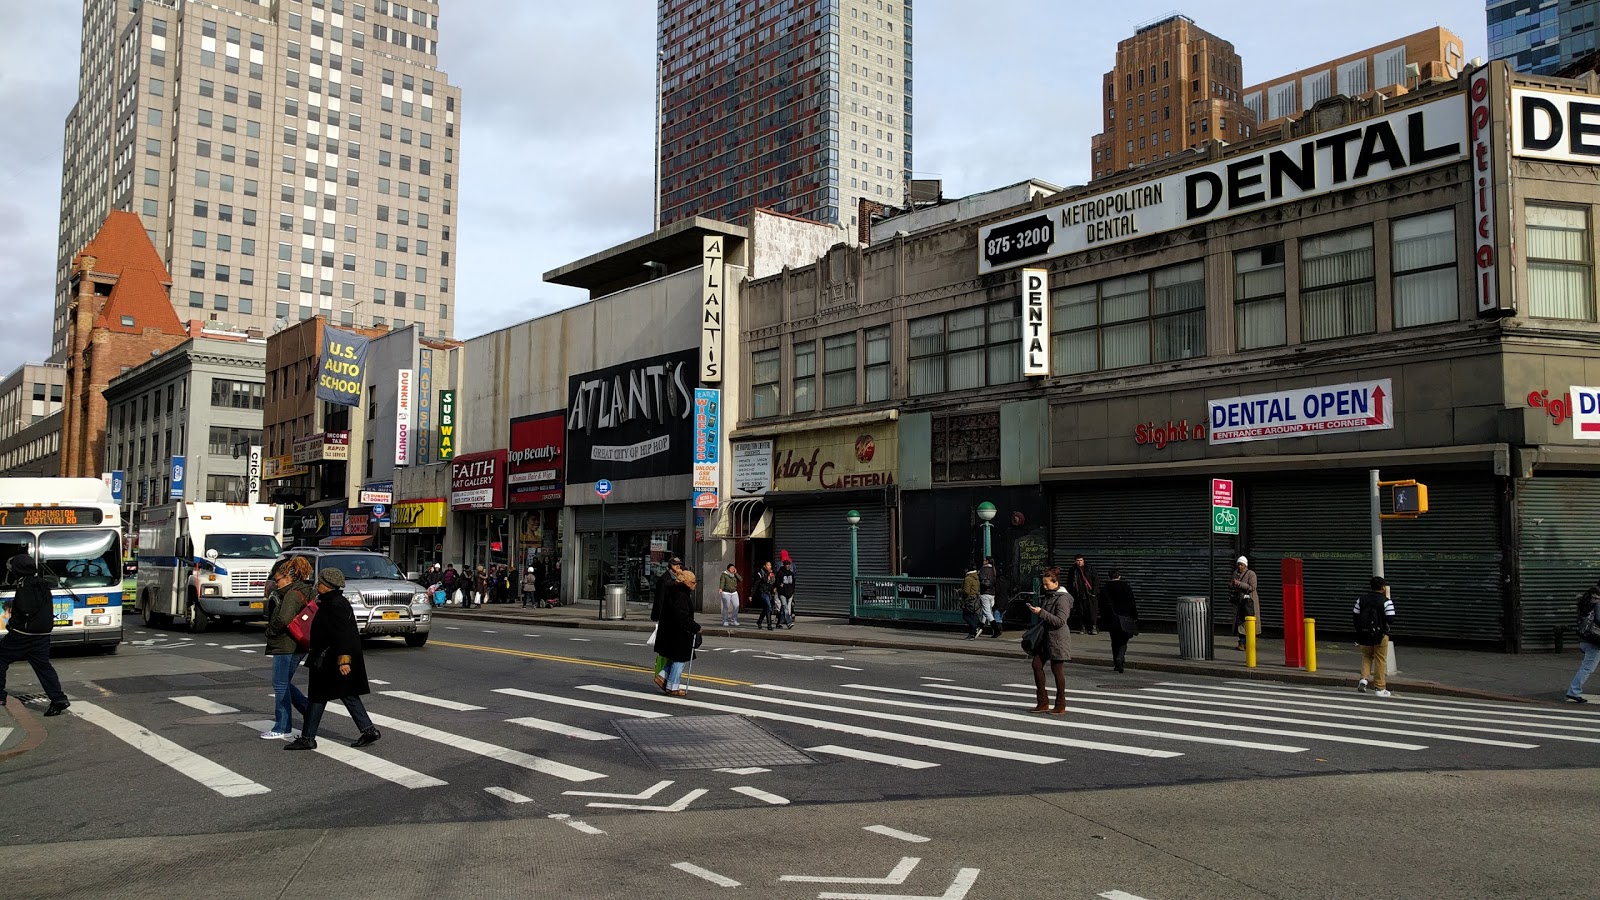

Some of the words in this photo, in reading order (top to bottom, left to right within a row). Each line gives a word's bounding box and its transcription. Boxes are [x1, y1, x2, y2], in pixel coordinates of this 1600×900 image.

[1185, 110, 1461, 221] DENTAL
[1062, 182, 1164, 228] METROPOLITAN
[987, 225, 1050, 256] 875-3200
[1087, 213, 1138, 244] DENTAL
[1029, 275, 1043, 368] DENTAL
[329, 341, 358, 360] U.S.
[324, 358, 360, 377] AUTO
[319, 375, 361, 395] SCHOOL
[400, 372, 409, 410] DUNKIN'
[1212, 397, 1296, 429] DENTAL
[1303, 388, 1368, 419] OPEN
[440, 393, 453, 458] SUBWAY
[696, 399, 708, 460] WIRELESS
[1134, 420, 1189, 449] Sight
[1216, 427, 1263, 440] ENTRANCE
[1264, 424, 1303, 435] AROUND
[1305, 421, 1325, 431] THE
[1326, 418, 1368, 429] CORNER
[398, 424, 407, 462] DONUTS
[593, 447, 614, 460] GREAT
[614, 448, 629, 460] CITY
[629, 445, 639, 458] OF
[640, 441, 652, 455] HIP
[652, 437, 668, 452] HOP
[249, 452, 260, 494] cricket
[452, 459, 495, 478] FAITH
[453, 480, 464, 488] ART
[465, 475, 494, 487] GALLERY
[819, 461, 894, 489] CAFETERIA
[26, 510, 75, 518] KENSINGTON
[301, 513, 318, 532] Sprint
[898, 583, 924, 594] Subway
